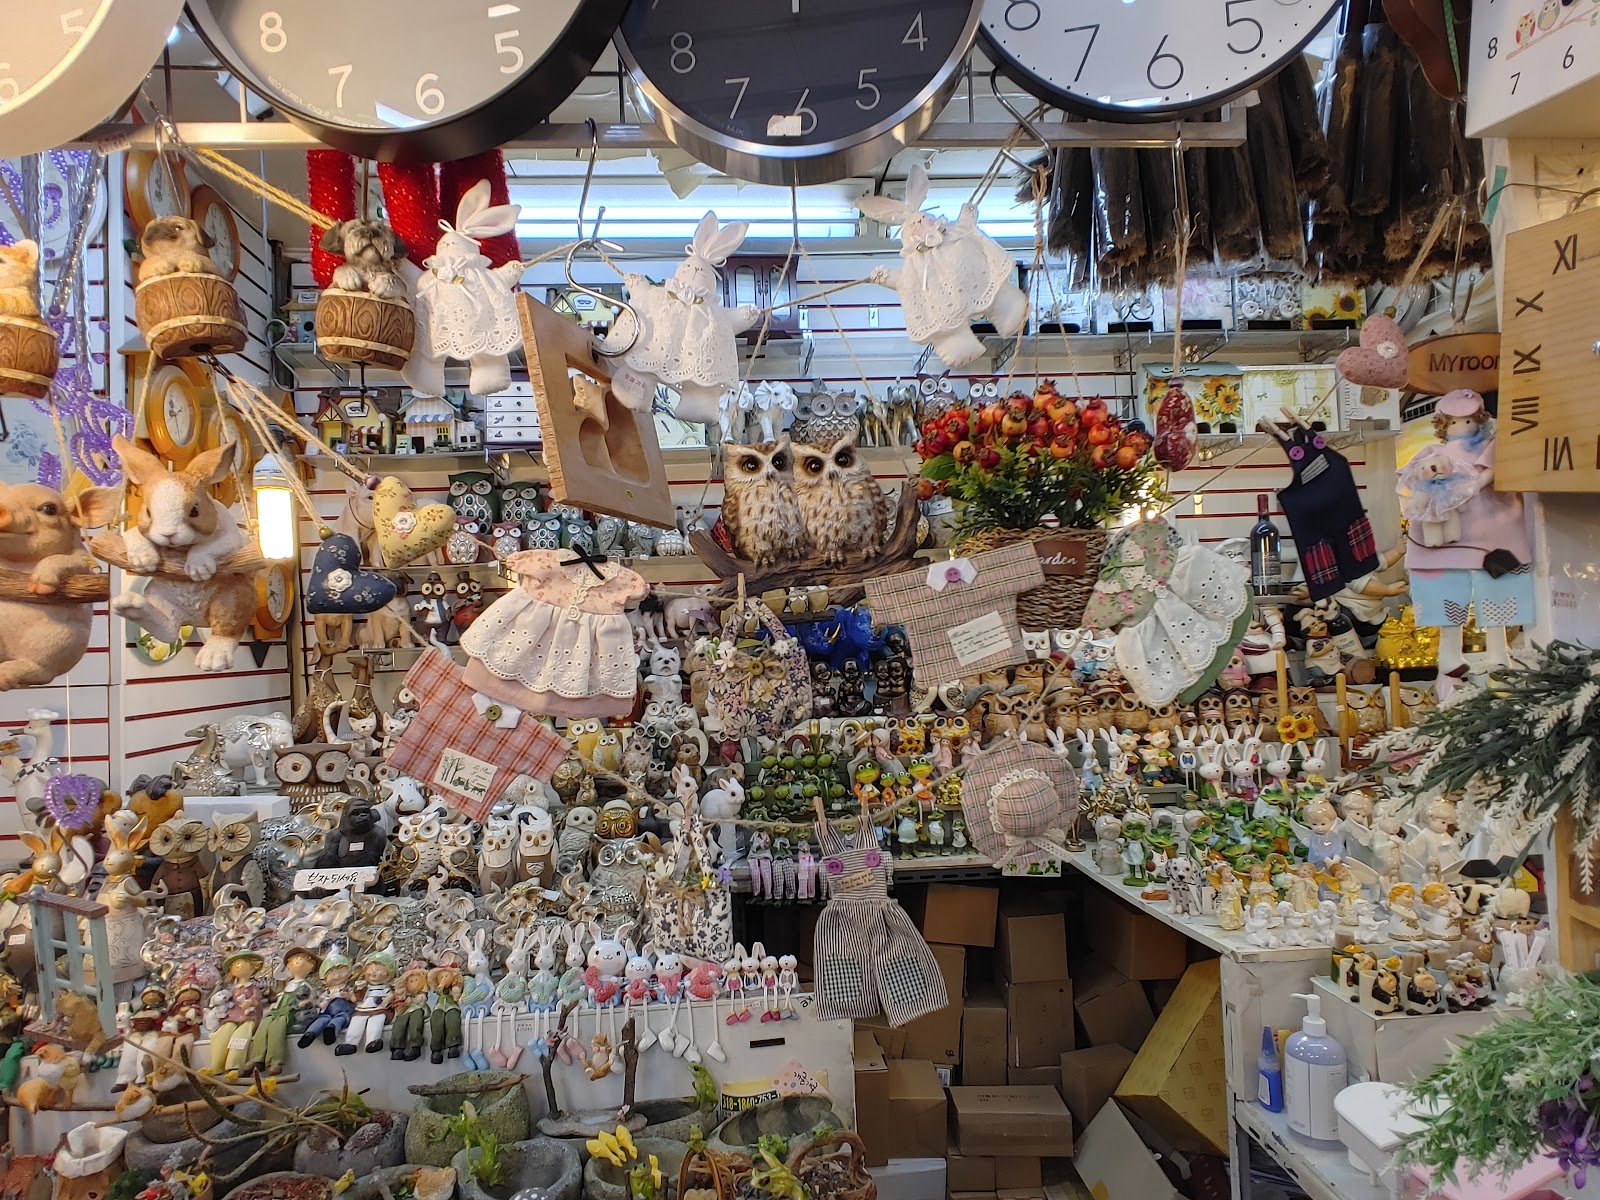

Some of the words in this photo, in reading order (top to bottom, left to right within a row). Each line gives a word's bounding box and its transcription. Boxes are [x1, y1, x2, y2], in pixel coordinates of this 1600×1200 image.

[260, 11, 287, 53] 8
[901, 11, 928, 51] 4
[1225, 0, 1263, 54] 5
[1487, 37, 1498, 59] 8
[494, 29, 524, 74] 5
[670, 31, 696, 74] 8
[1064, 24, 1100, 82] 7
[1146, 34, 1184, 89] 6
[1562, 45, 1574, 69] 6
[328, 64, 352, 108] 7
[415, 73, 445, 115] 6
[724, 77, 750, 119] 7
[855, 67, 881, 110] 5
[1510, 71, 1521, 95] 7
[793, 88, 818, 135] 6
[1552, 233, 1578, 275] XI
[1469, 271, 1476, 283] 6
[1515, 290, 1544, 317] X
[1513, 344, 1542, 375] IX
[1510, 396, 1540, 436] VIII
[1039, 551, 1078, 565] arden
